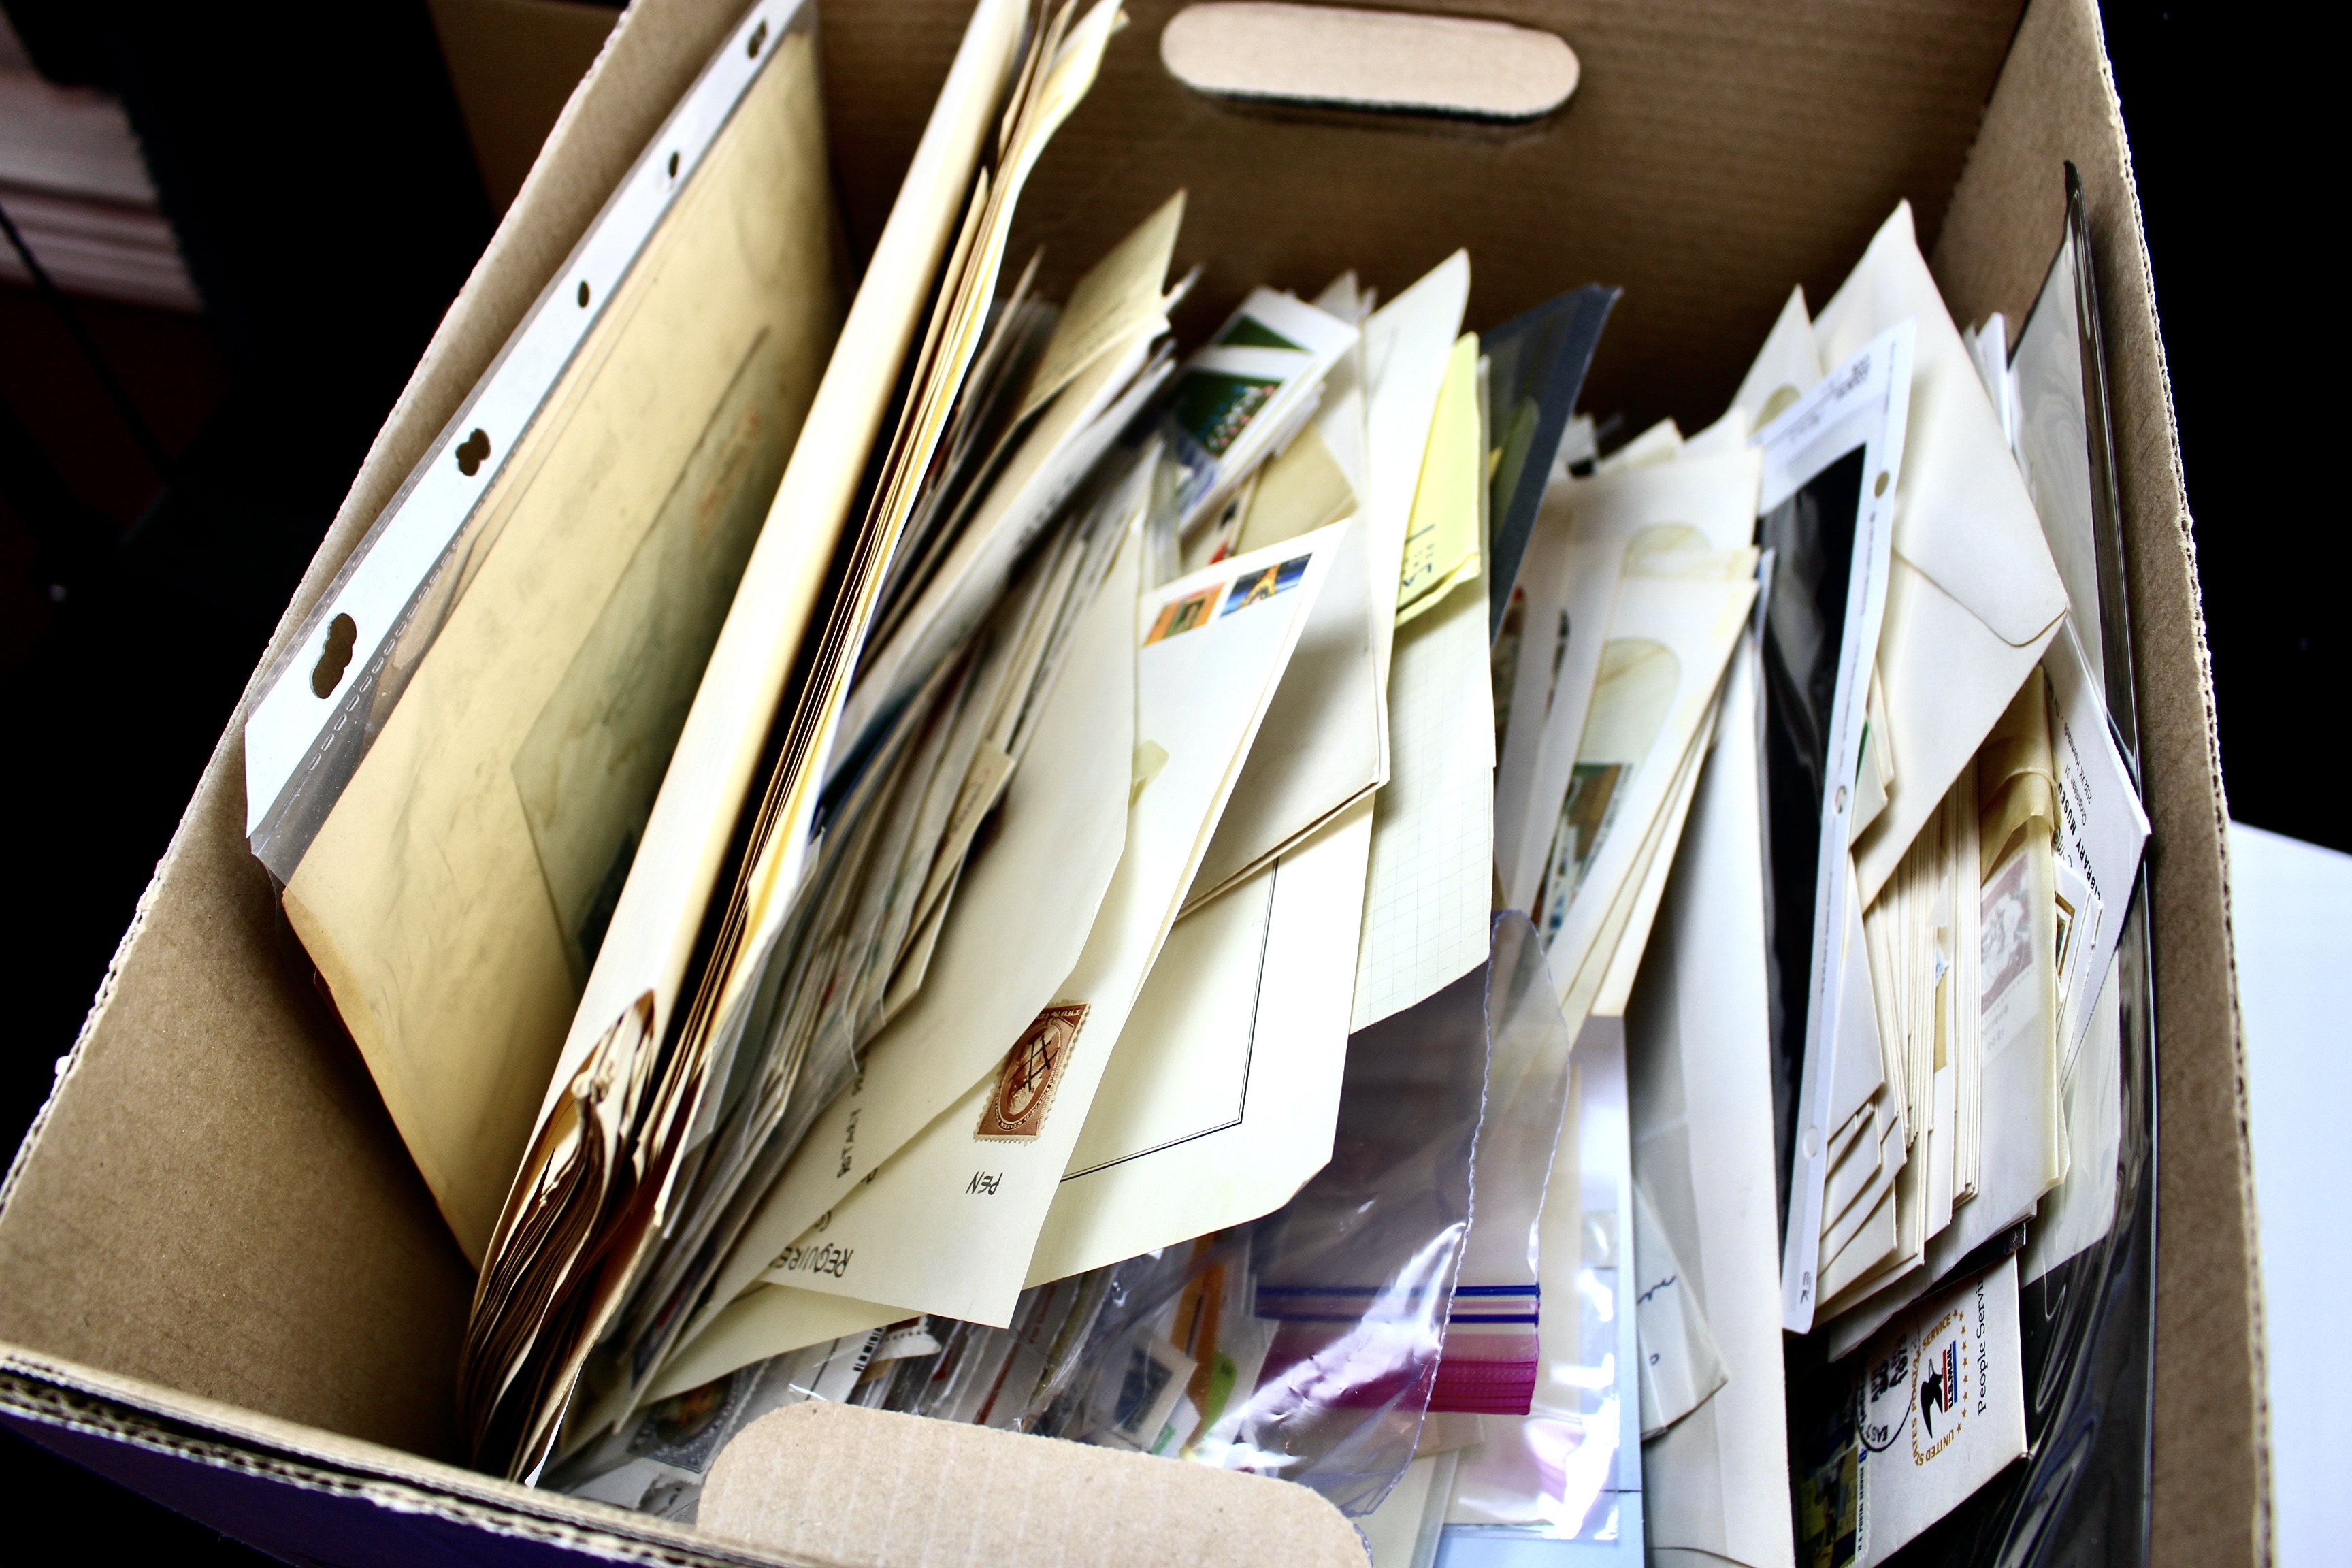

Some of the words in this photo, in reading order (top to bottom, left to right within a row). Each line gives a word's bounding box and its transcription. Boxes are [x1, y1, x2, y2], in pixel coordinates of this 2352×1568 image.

[2065, 763, 2071, 779] 31
[2058, 782, 2077, 836] MUSEU
[1000, 1120, 1023, 1130] STATES
[965, 1171, 1003, 1195] PEN
[770, 1243, 853, 1278] REQUIRE
[1976, 1273, 1985, 1339] Servin
[1922, 1313, 1952, 1352] SERVICE
[1872, 1367, 1880, 1403] APR
[1911, 1349, 1921, 1413] POSTAL
[1978, 1341, 1988, 1416] People
[1911, 1418, 1924, 1466] STATES
[1926, 1428, 1955, 1462] UNITED
